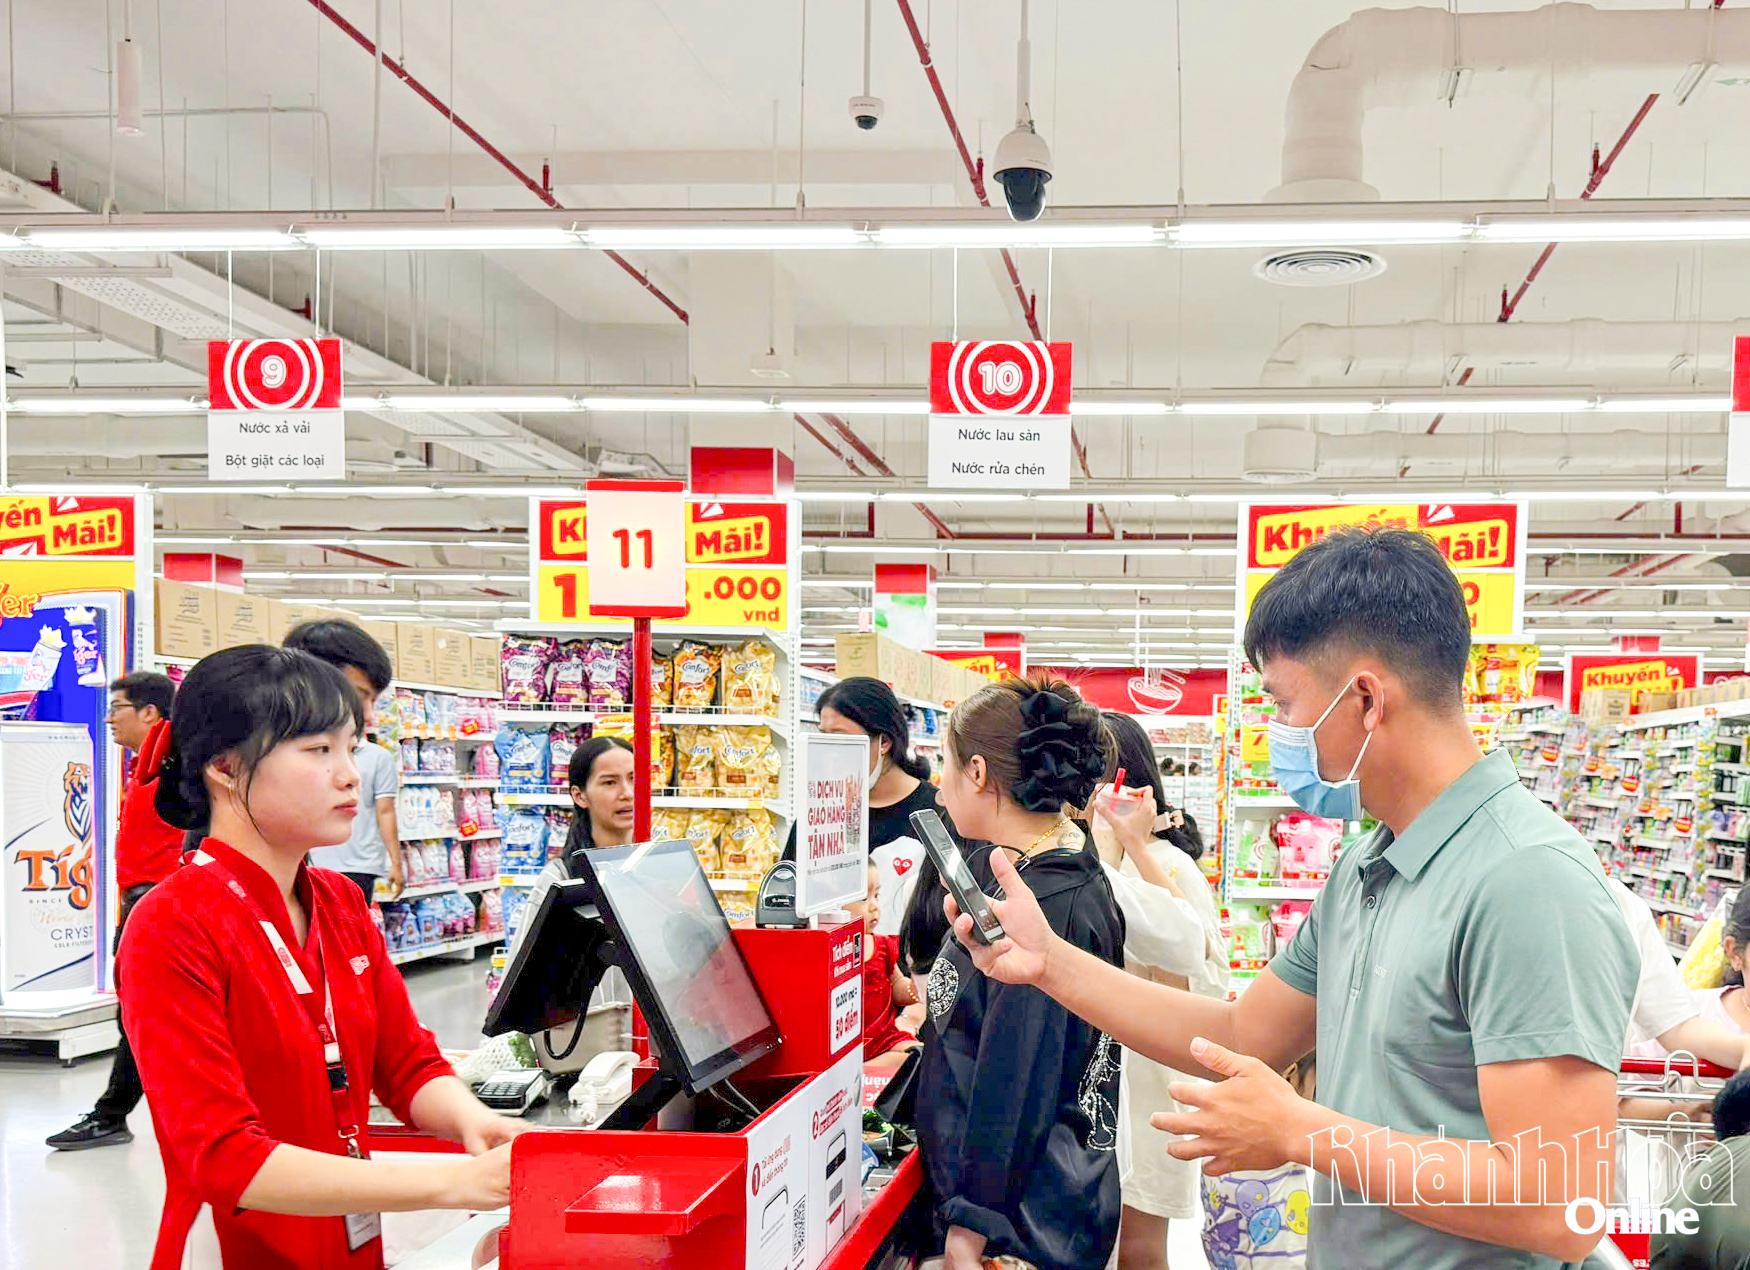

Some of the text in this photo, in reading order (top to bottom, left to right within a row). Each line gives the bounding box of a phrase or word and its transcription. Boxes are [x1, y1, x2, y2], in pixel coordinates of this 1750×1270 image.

[260, 355, 287, 388] 9
[978, 361, 1023, 395] 10
[239, 422, 270, 434] Nước
[958, 428, 991, 441] Nước
[996, 429, 1015, 441] lau
[225, 454, 325, 468] Bột giặt các loại
[952, 461, 985, 474] Nước
[1014, 462, 1046, 475] chén
[53, 514, 117, 549] Mãi!
[695, 521, 764, 556] Mãi!
[612, 528, 654, 569] 11
[1586, 664, 1661, 687] Khuyến
[817, 780, 834, 805] DỊCH
[808, 800, 846, 828] GIAO HÀNG
[827, 824, 845, 857] NHÀ
